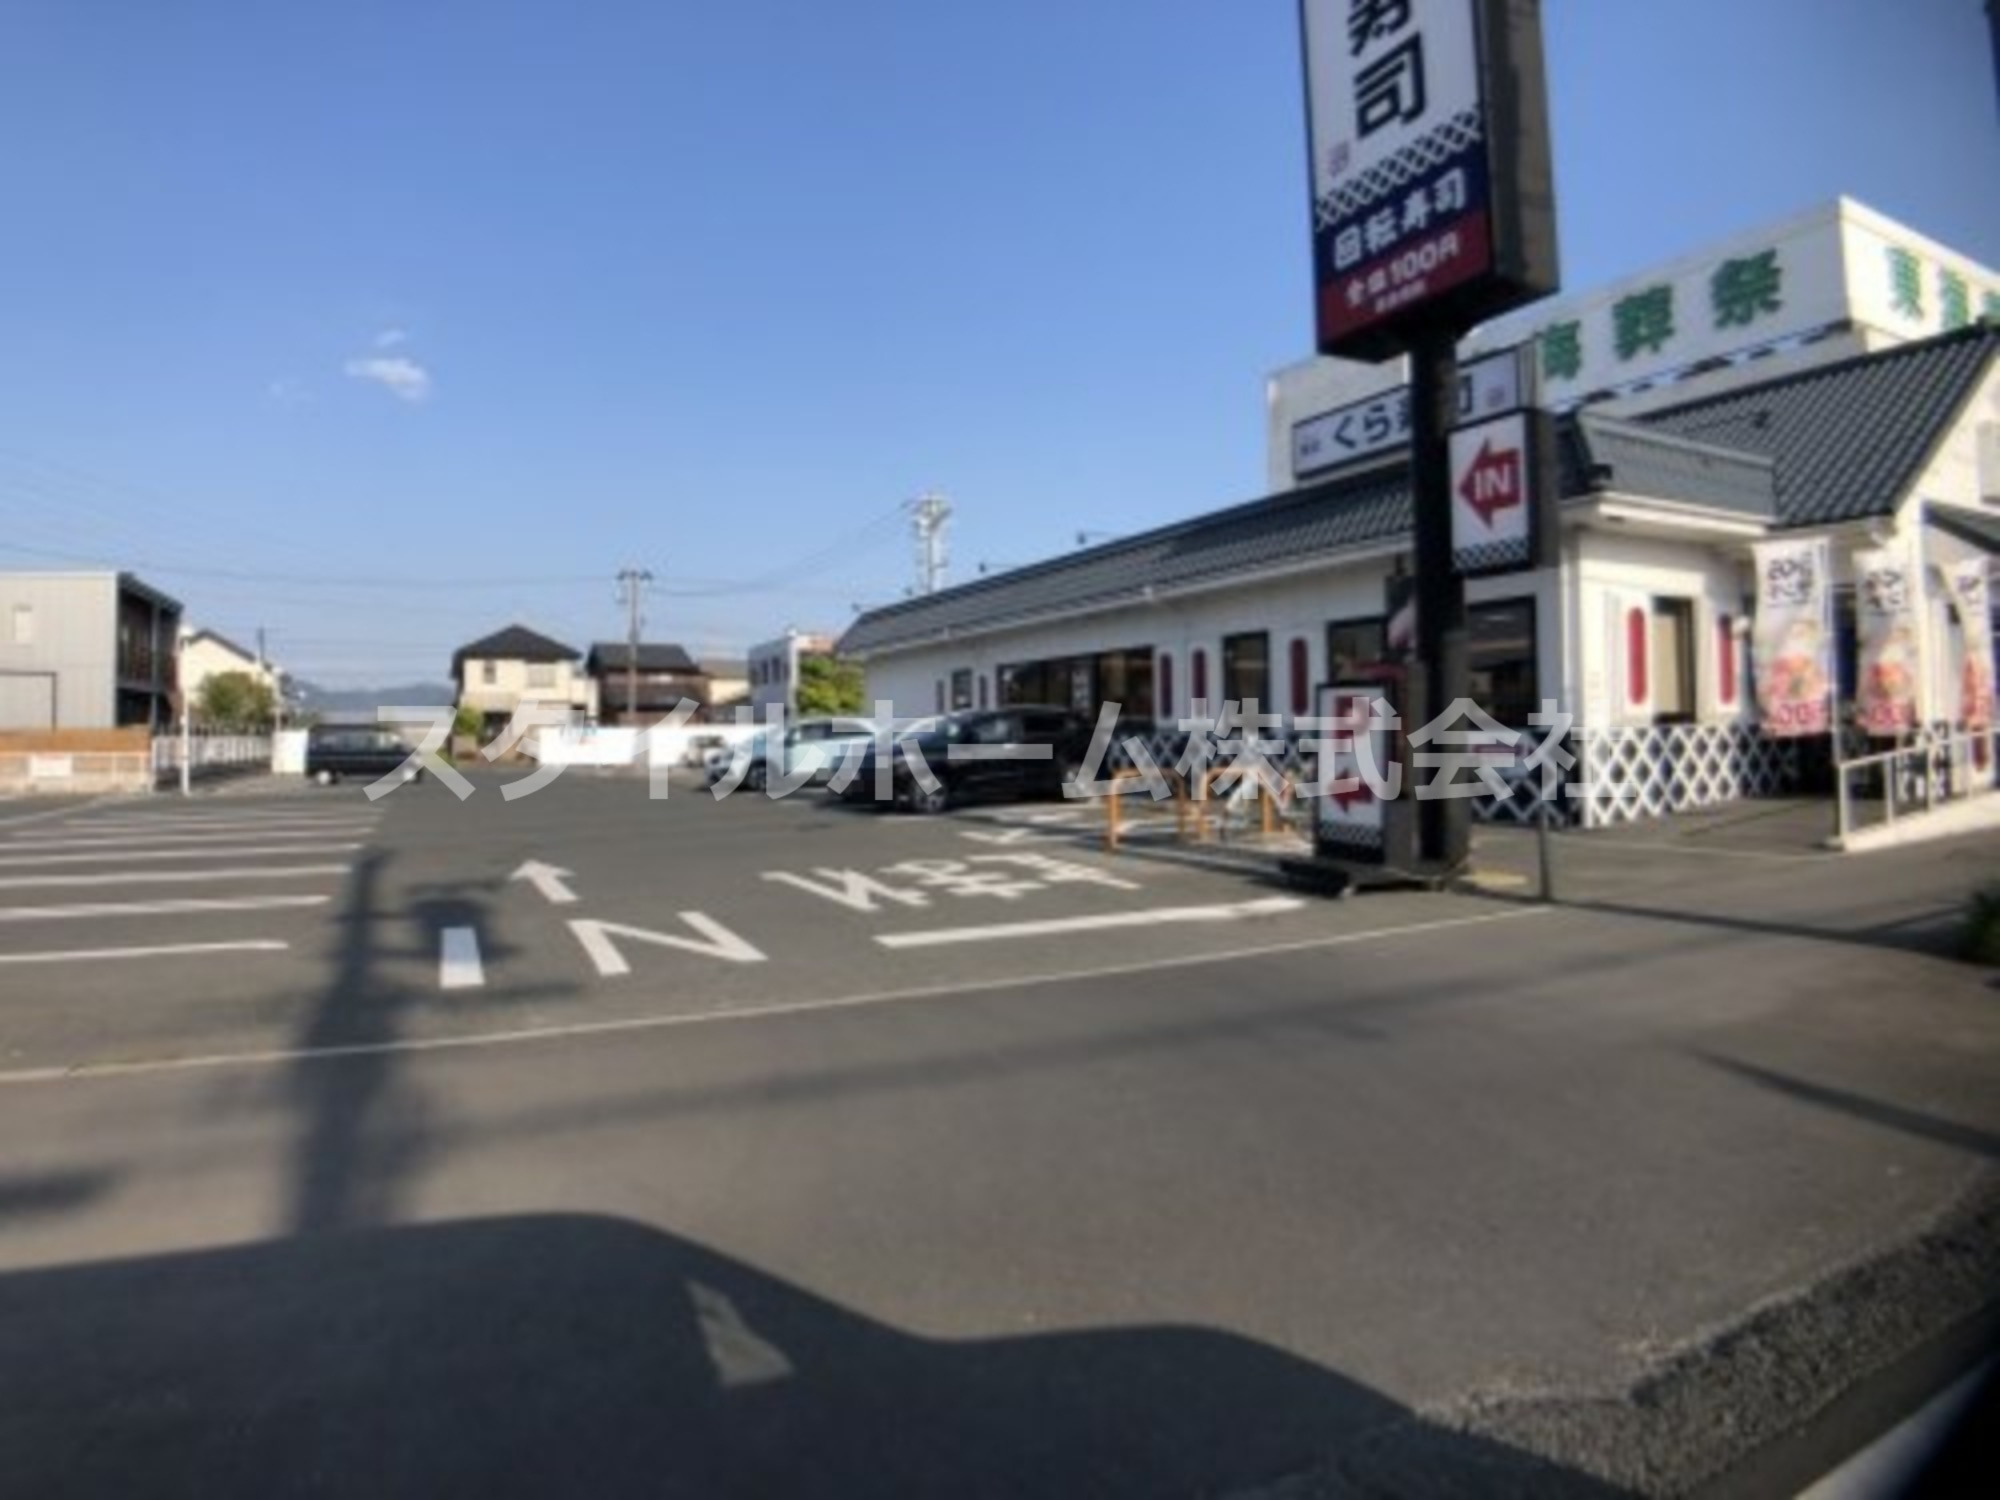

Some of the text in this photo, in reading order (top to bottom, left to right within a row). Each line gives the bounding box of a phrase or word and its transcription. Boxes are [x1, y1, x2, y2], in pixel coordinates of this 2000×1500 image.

[1334, 168, 1466, 271] 回転寿司
[1474, 463, 1510, 502] IN
[439, 909, 769, 990] IN
